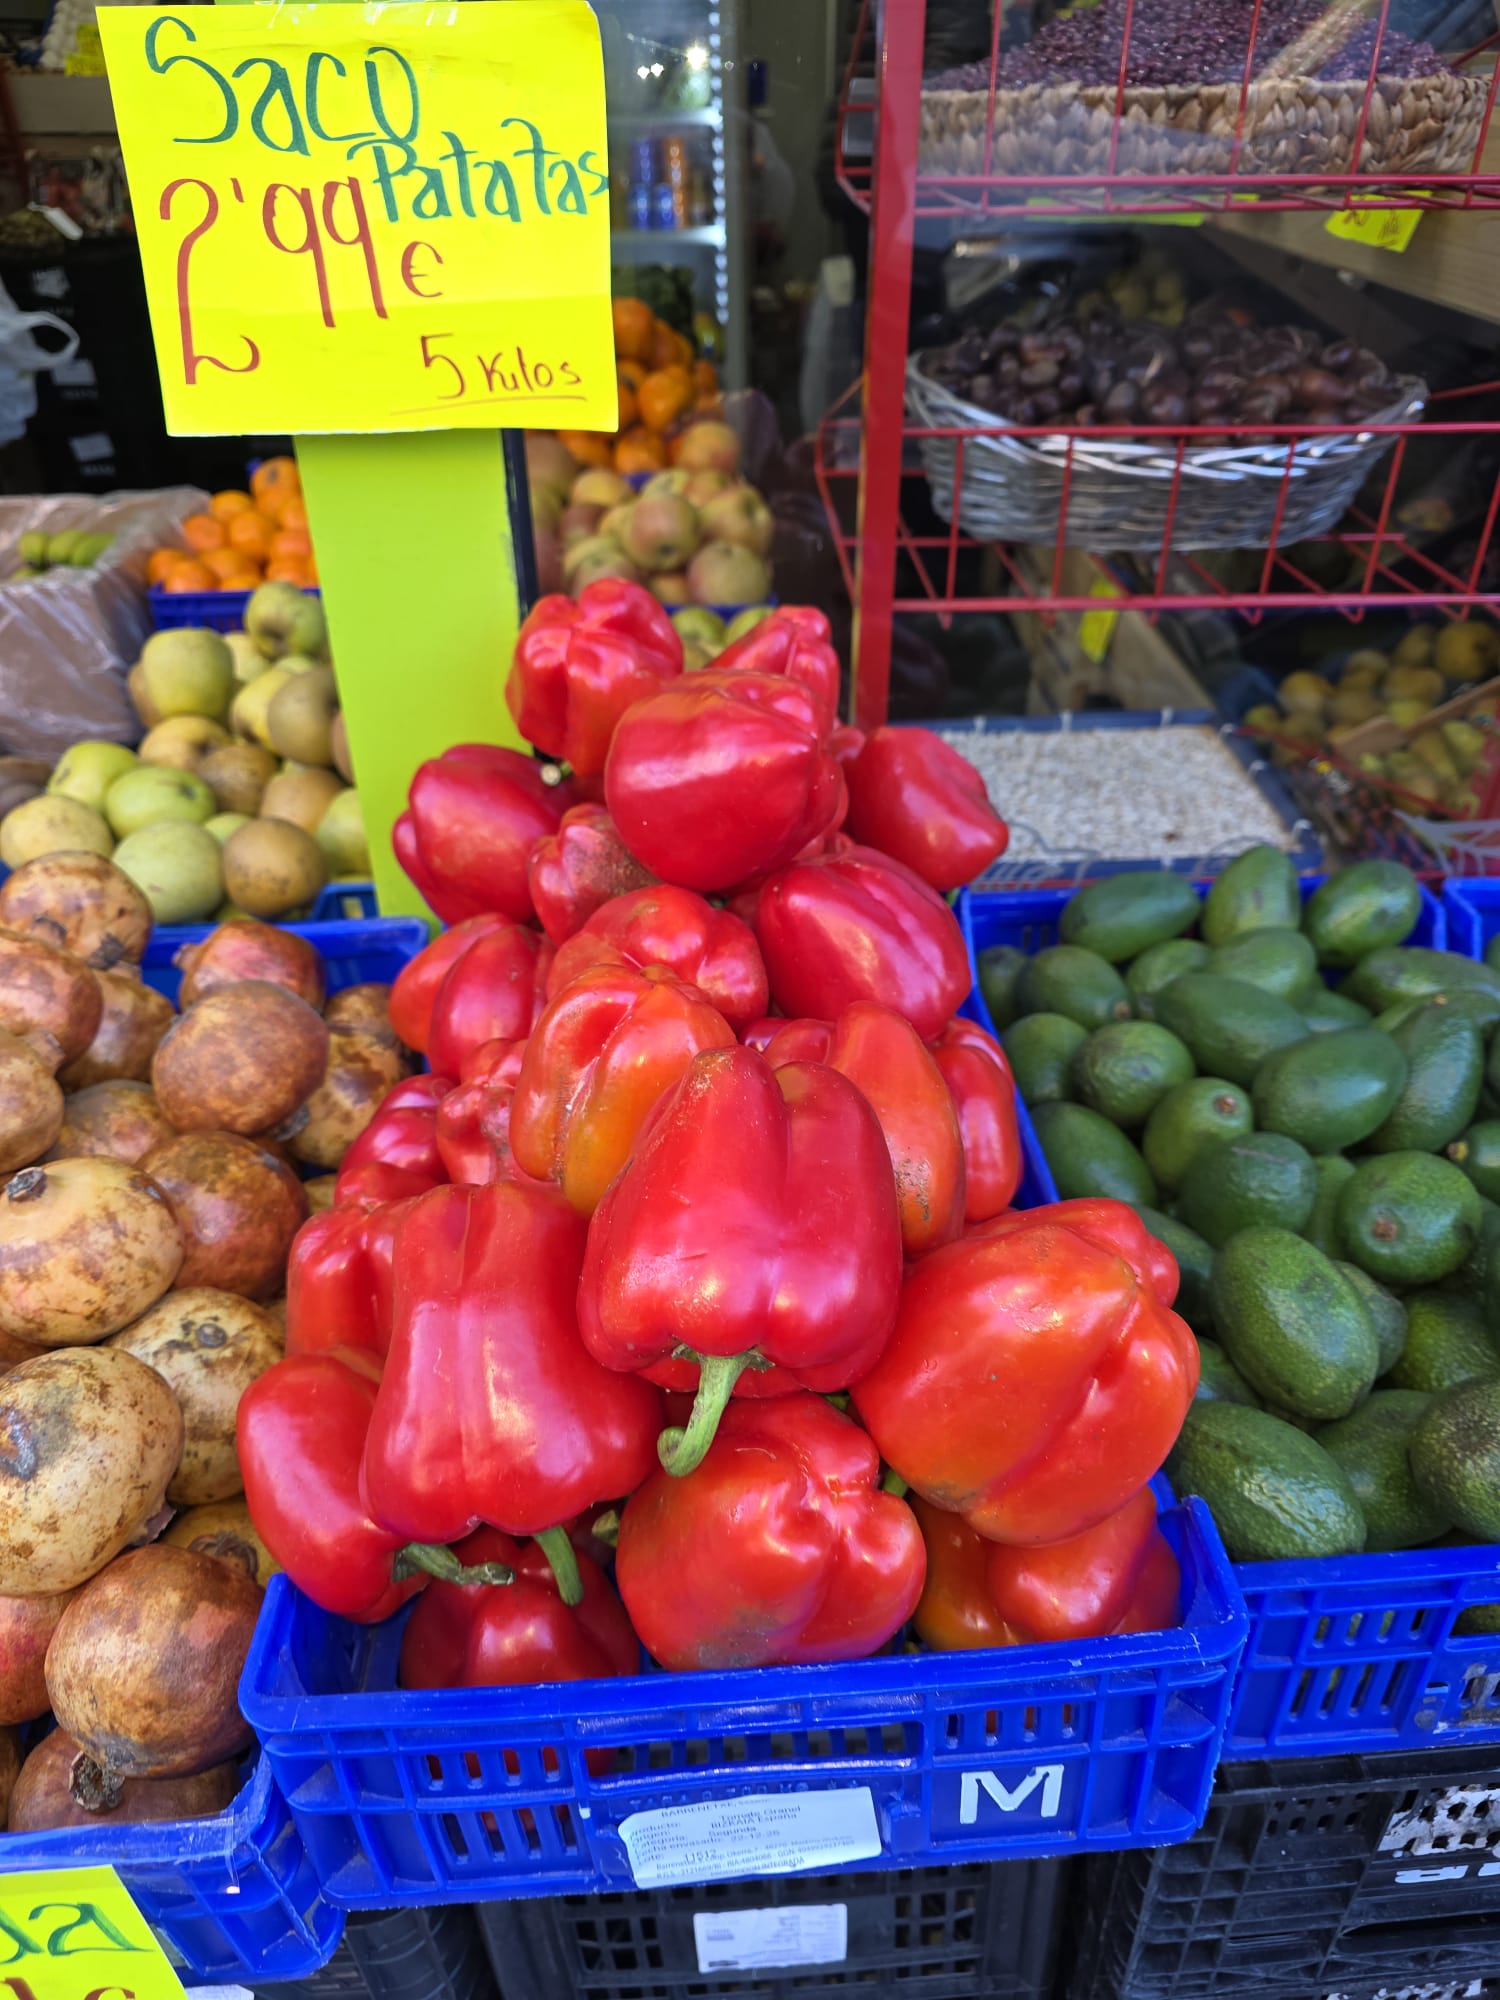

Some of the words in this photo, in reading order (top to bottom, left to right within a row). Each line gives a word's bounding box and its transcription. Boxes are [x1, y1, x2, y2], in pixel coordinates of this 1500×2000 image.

[145, 16, 420, 156] Saco
[347, 118, 609, 223] Patatas
[420, 333, 466, 399] 5
[960, 1764, 1064, 1824] M
